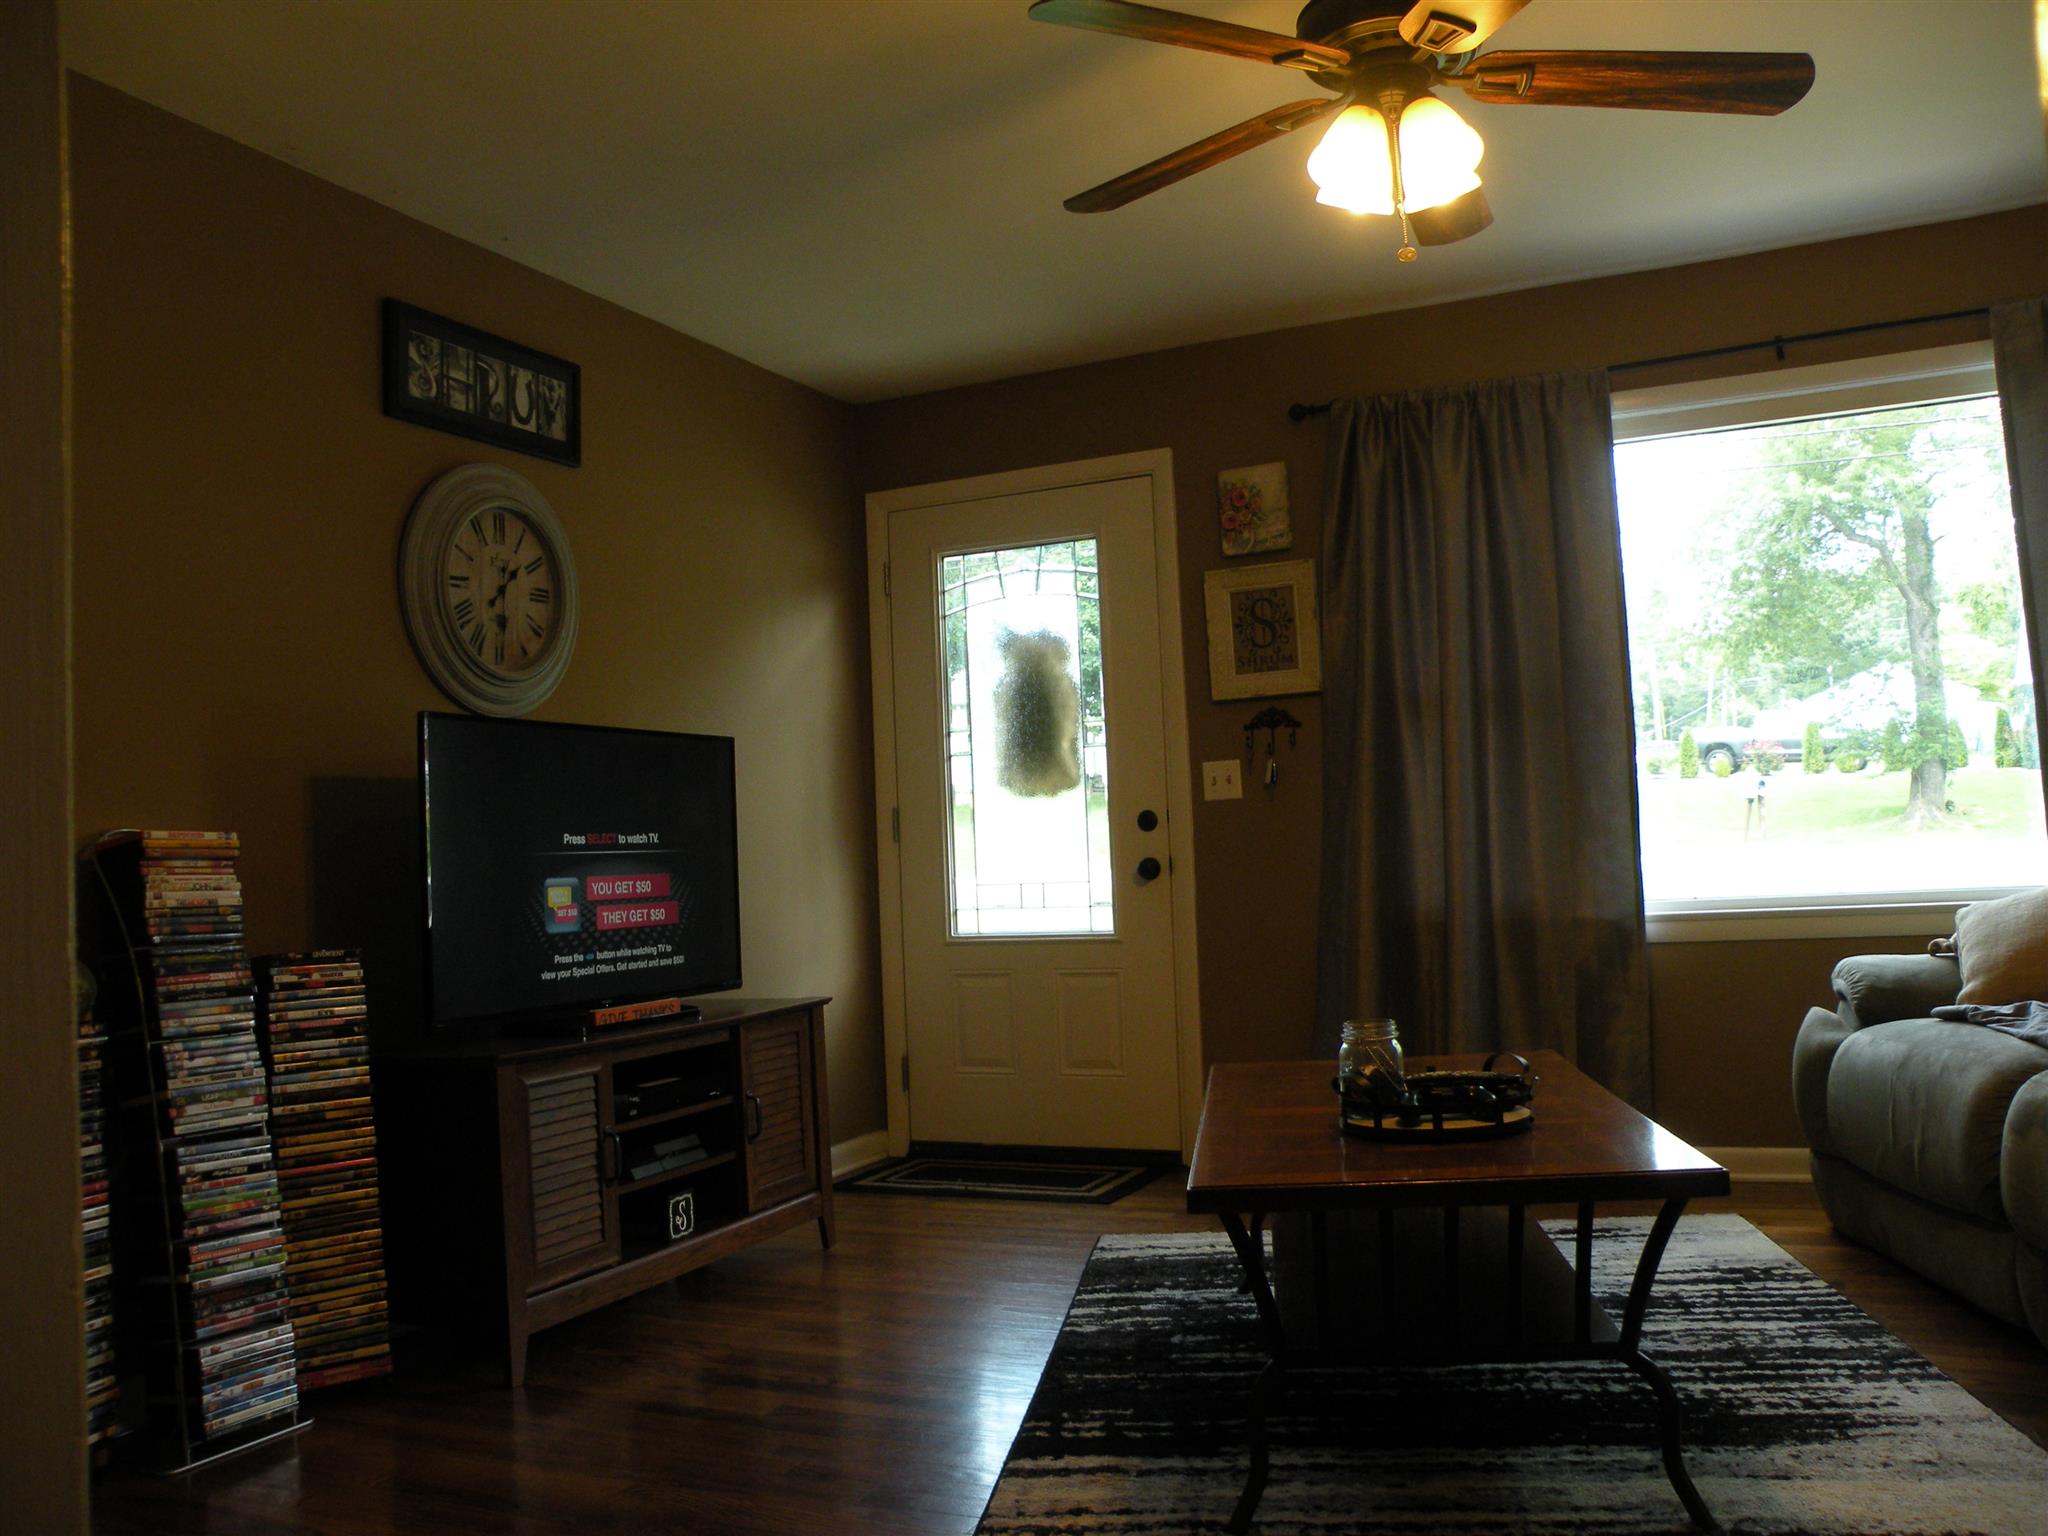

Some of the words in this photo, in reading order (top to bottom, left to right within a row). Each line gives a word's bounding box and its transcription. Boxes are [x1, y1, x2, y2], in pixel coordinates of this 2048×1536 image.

[563, 833, 586, 844] Press
[618, 833, 626, 844] to
[627, 833, 647, 844] watch
[592, 882, 612, 895] YOU
[615, 881, 634, 894] GET
[636, 880, 651, 893] $50
[603, 910, 628, 924] THEY
[629, 909, 648, 922] GET
[650, 908, 665, 921] $50
[554, 954, 573, 964] Press
[574, 953, 584, 962] the
[596, 950, 616, 960] button
[616, 948, 631, 957] while
[632, 945, 657, 956] watching
[657, 944, 665, 953] TV
[665, 943, 672, 952] to
[541, 970, 556, 980] view
[557, 969, 572, 981] your
[572, 964, 595, 978] Special
[616, 962, 627, 971] Get
[628, 960, 648, 970] started
[648, 958, 659, 967] and
[660, 957, 673, 967] save
